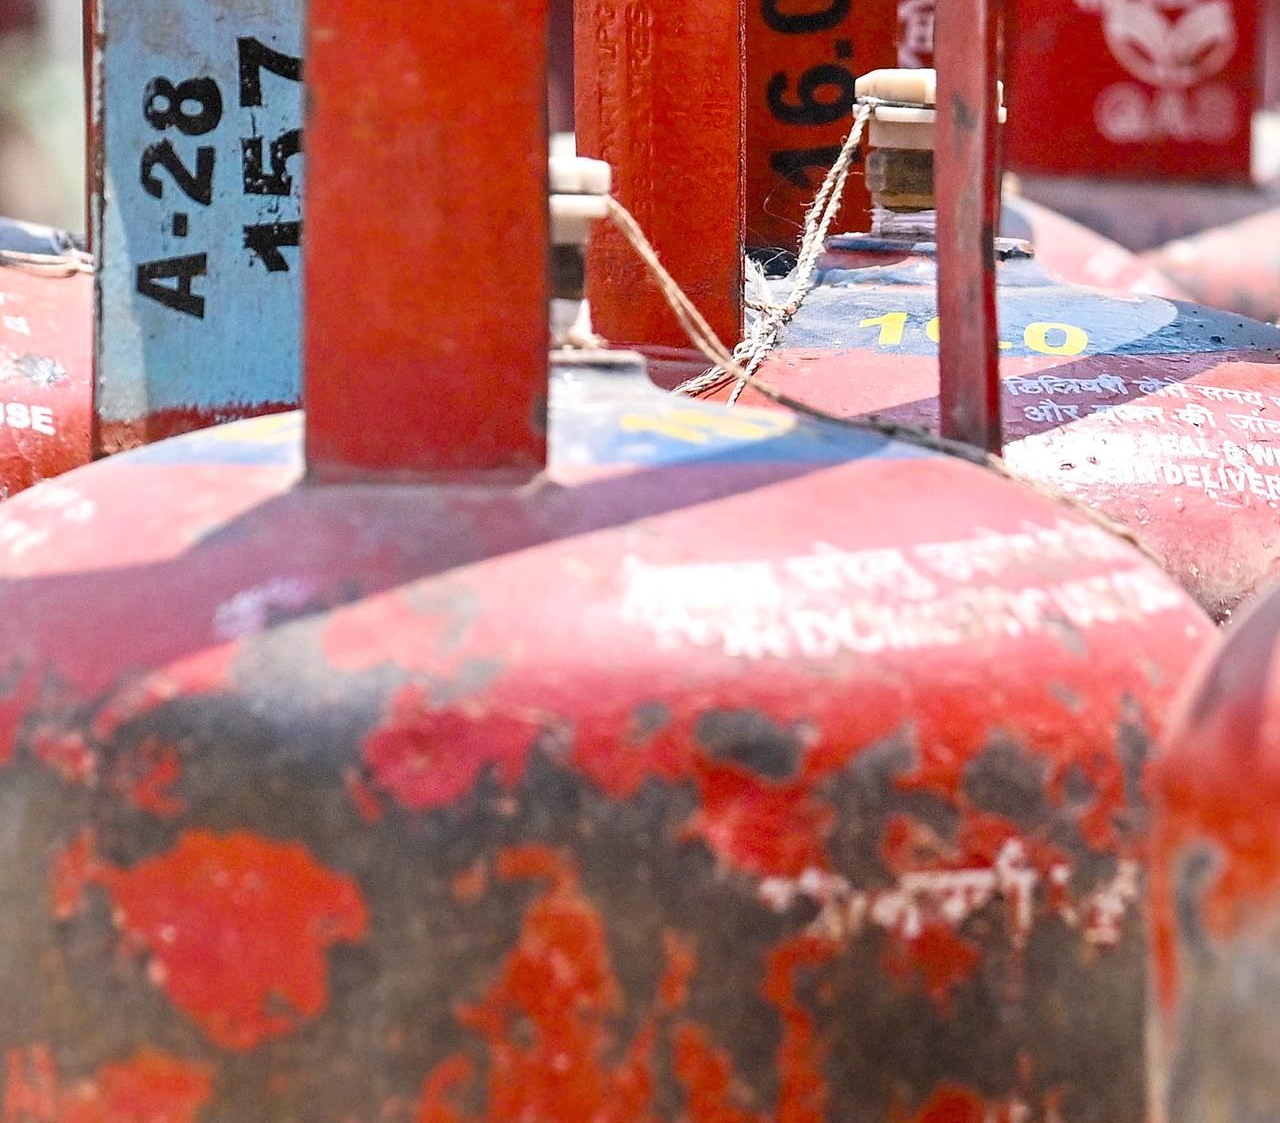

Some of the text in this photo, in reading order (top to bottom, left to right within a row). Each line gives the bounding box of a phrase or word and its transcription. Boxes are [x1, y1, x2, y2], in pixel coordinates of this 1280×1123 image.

[136, 76, 223, 320] A-28
[236, 36, 304, 274] 157
[859, 311, 1089, 357] 1.0
